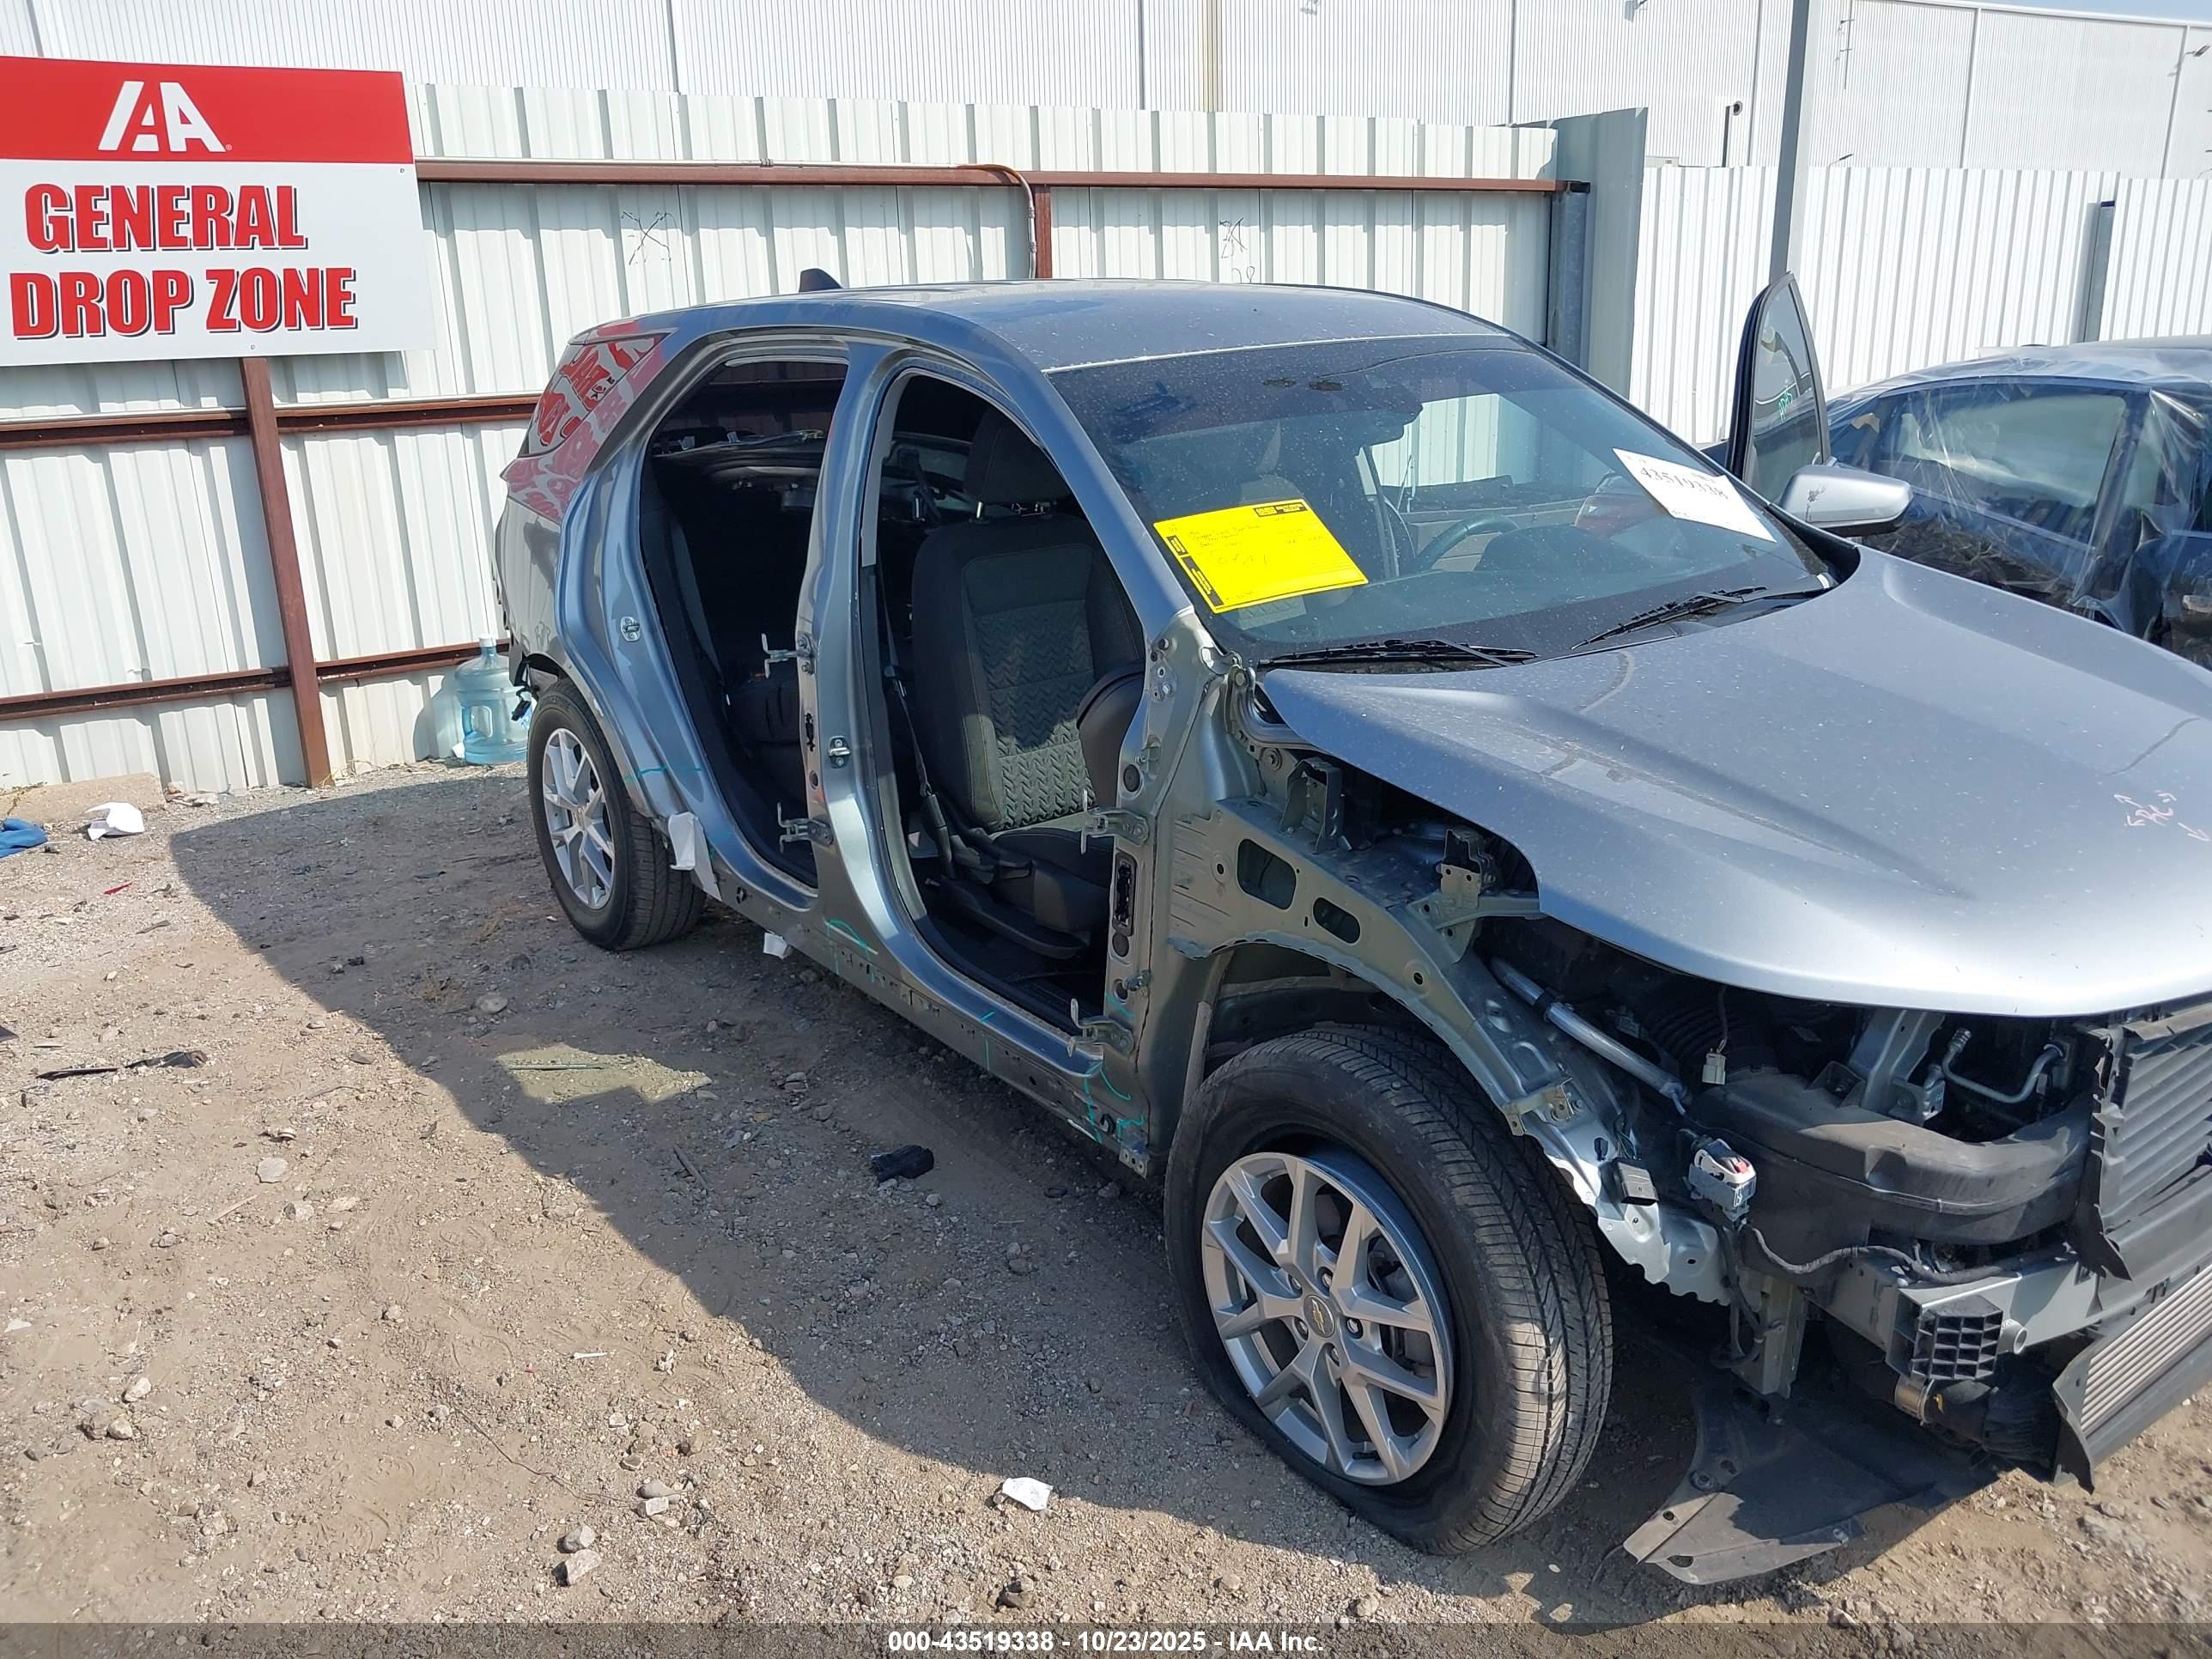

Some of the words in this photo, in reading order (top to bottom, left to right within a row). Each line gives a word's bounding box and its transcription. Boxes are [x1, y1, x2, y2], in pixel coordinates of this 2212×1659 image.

[25, 184, 308, 254] GENERAL
[9, 269, 195, 340] DROP
[205, 267, 358, 333] ZONE
